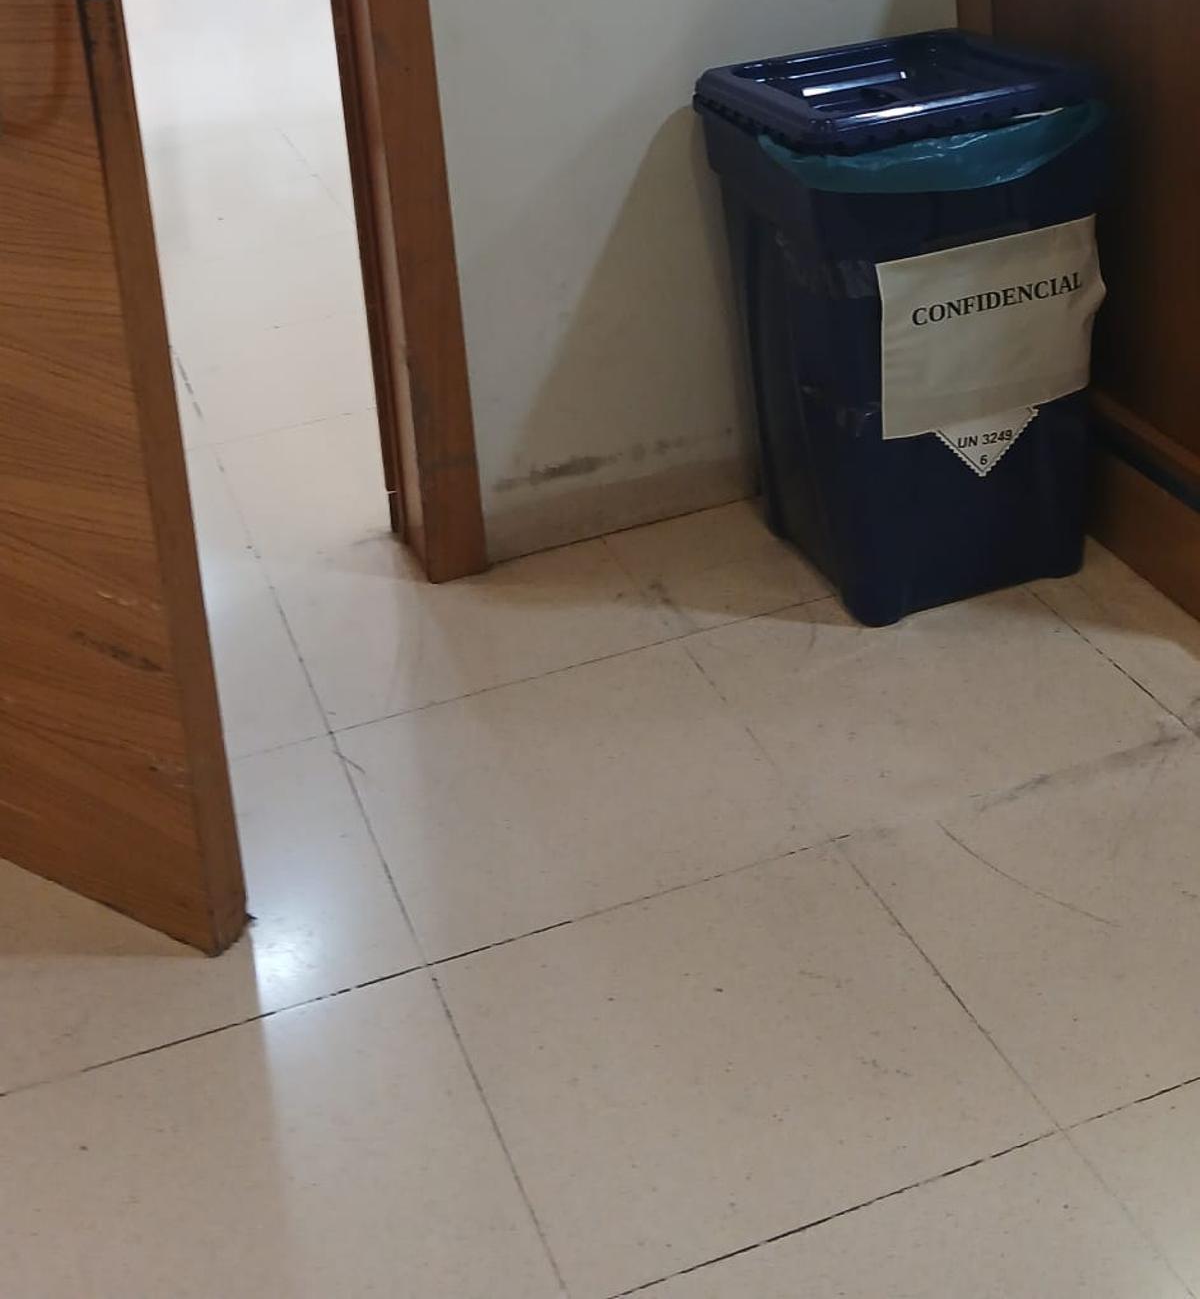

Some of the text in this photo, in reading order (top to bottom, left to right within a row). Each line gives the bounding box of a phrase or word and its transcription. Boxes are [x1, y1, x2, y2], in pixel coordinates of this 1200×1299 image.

[911, 272, 1082, 327] CONFIDENCIAL
[957, 435, 978, 449] UN
[979, 454, 988, 466] 6
